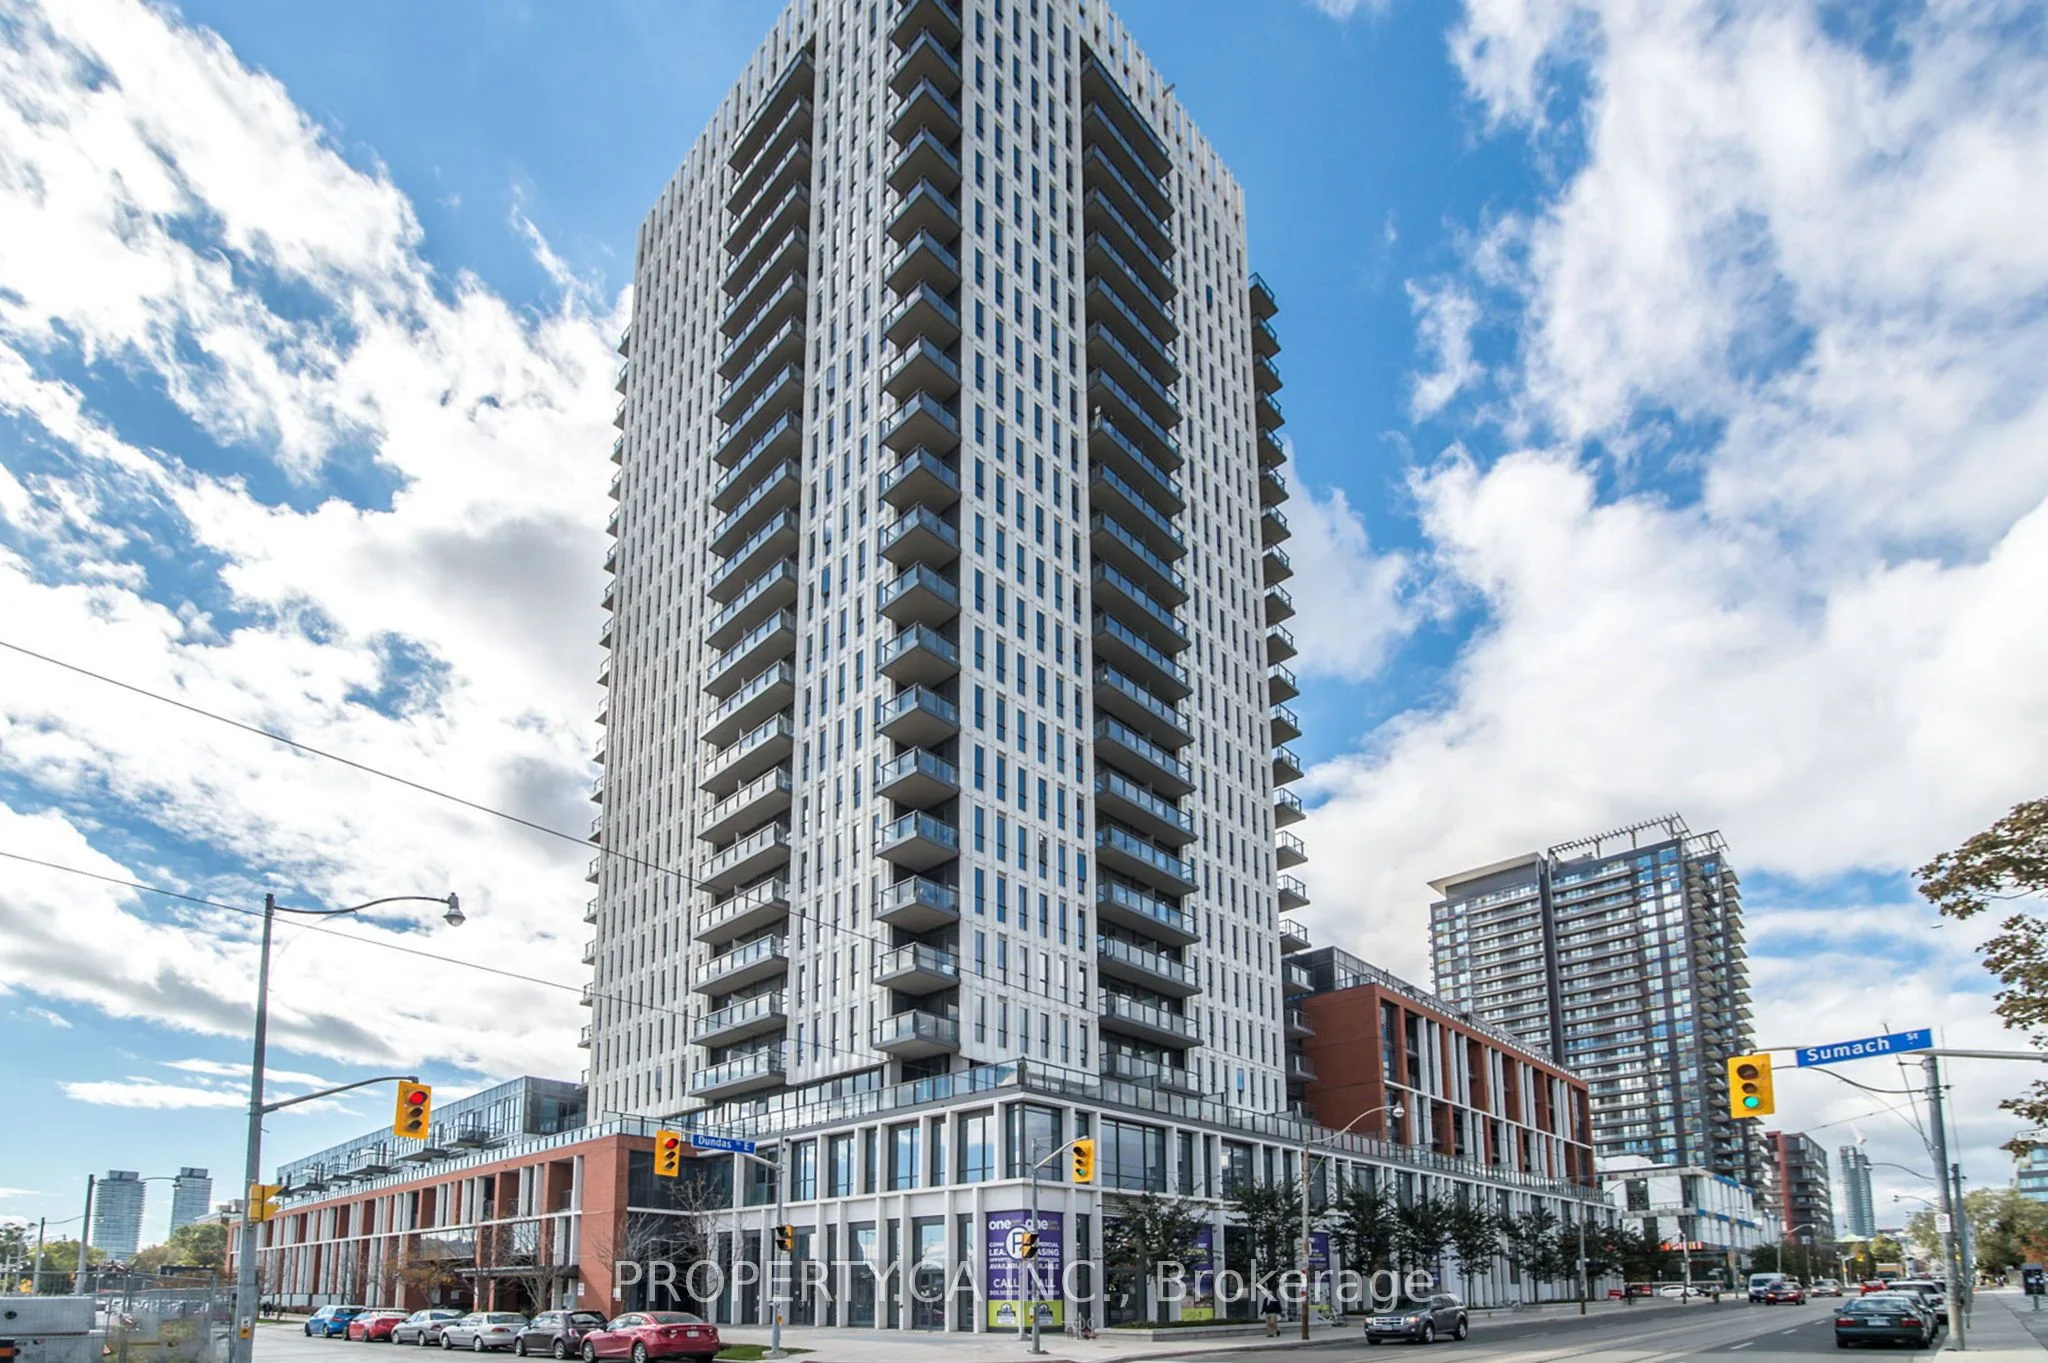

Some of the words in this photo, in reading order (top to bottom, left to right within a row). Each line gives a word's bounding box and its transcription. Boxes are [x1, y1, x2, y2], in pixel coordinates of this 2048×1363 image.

[1806, 1038, 1890, 1061] Sumach
[1906, 1031, 1919, 1040] St
[698, 1135, 732, 1148] Dundas
[744, 1141, 750, 1151] E
[989, 1219, 1012, 1230] one
[993, 1278, 1020, 1288] CALL
